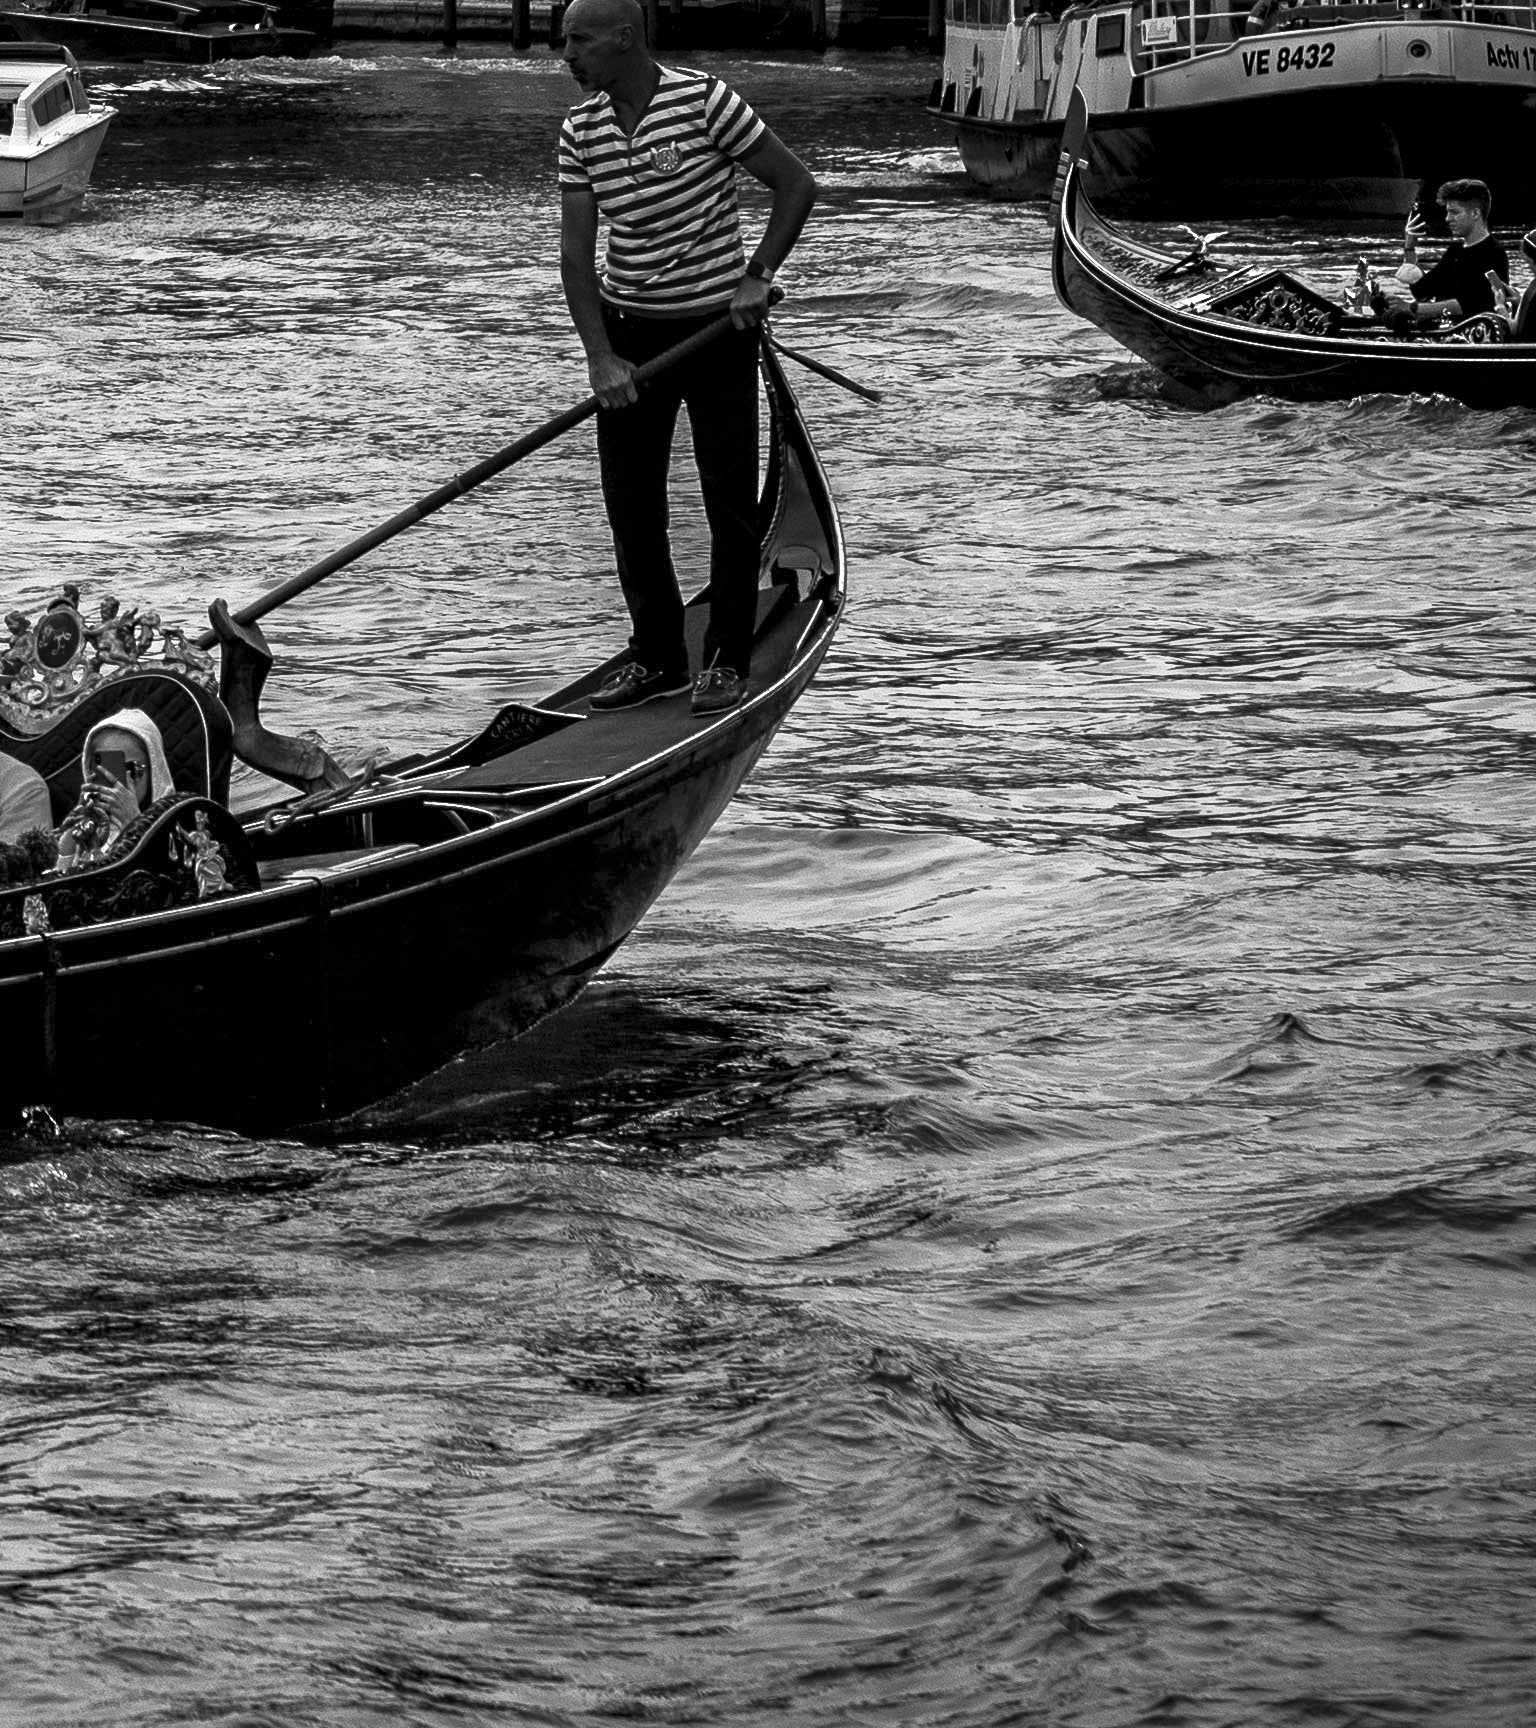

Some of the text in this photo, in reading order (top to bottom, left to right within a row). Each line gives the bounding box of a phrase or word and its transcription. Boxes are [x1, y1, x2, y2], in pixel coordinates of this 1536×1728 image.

[1242, 42, 1336, 77] VE 8432
[1487, 41, 1520, 70] Actv
